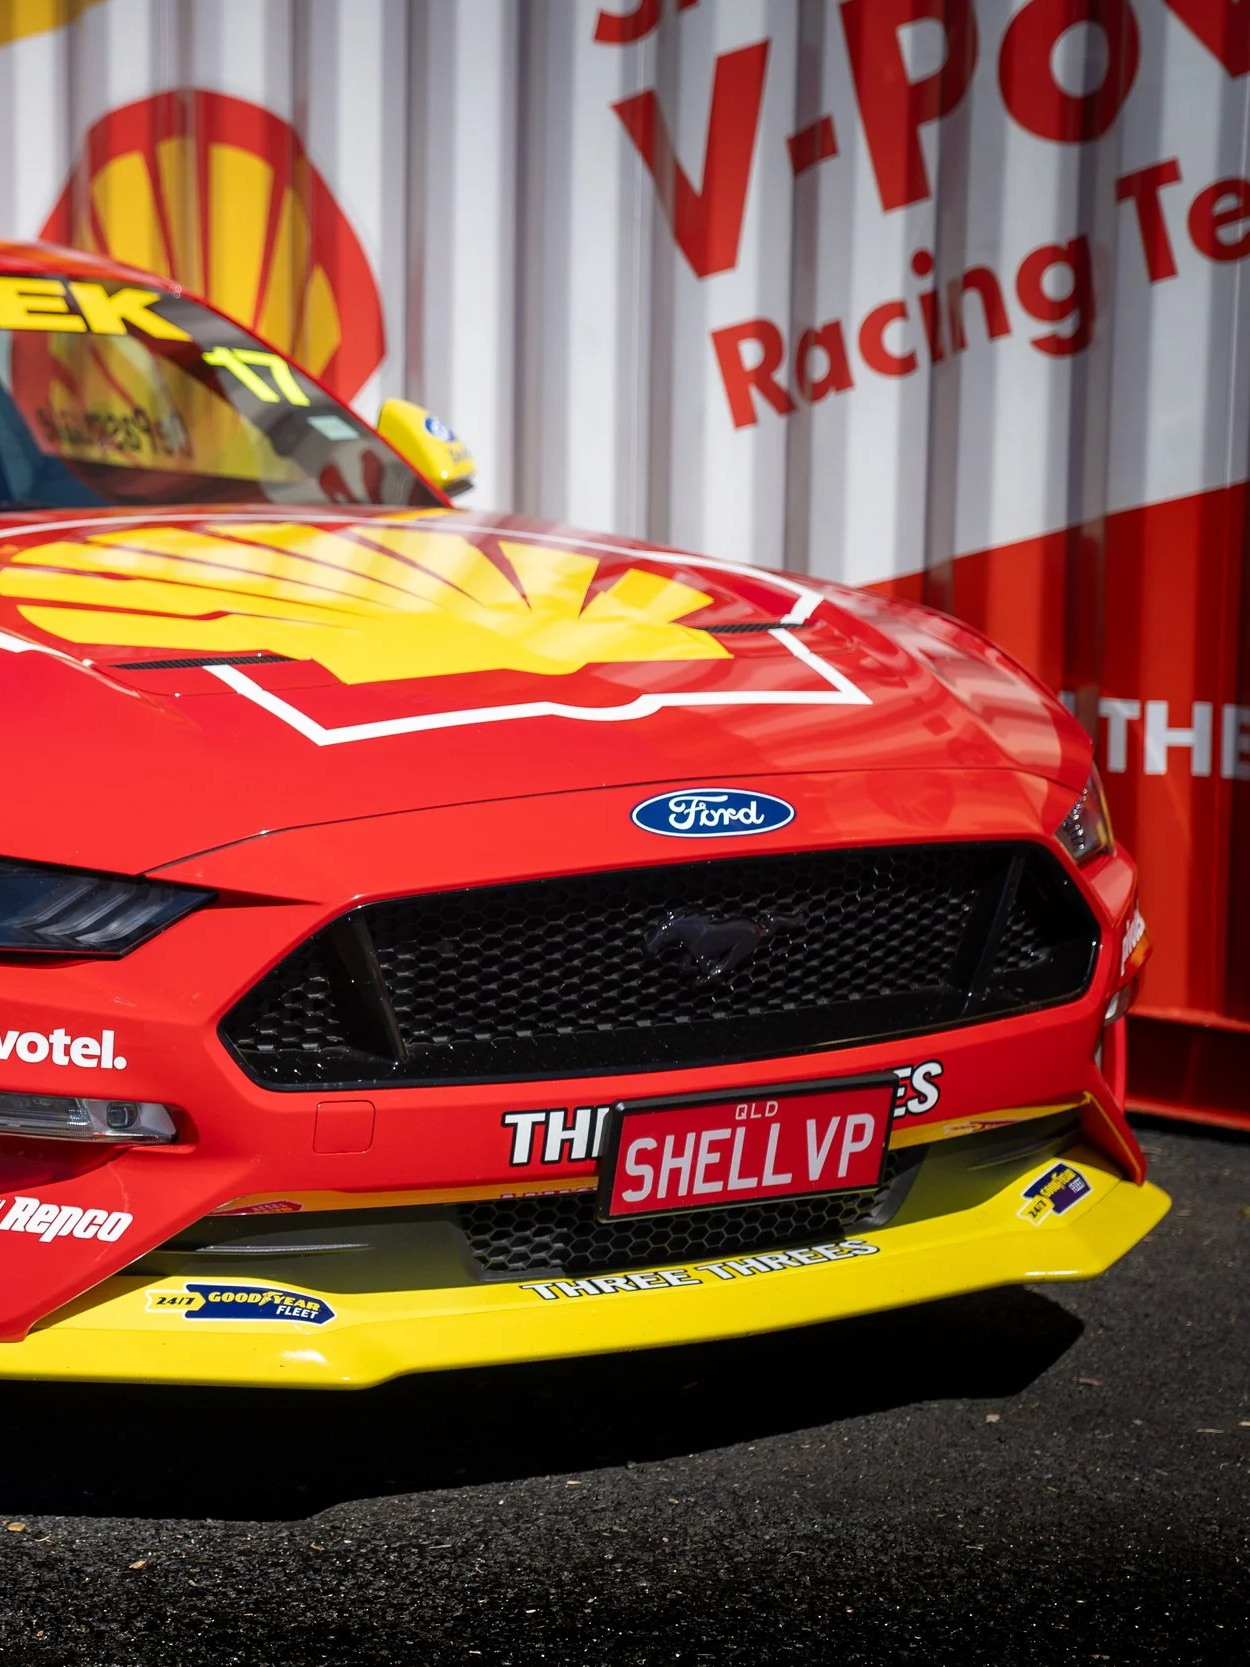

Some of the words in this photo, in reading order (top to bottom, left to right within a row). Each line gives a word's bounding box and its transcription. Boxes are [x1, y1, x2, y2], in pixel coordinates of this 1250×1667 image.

[612, 0, 1250, 282] V-Po
[710, 234, 1095, 430] Racing
[202, 346, 311, 407] 17
[668, 795, 765, 830] Ford
[735, 1100, 779, 1121] QLD
[520, 1268, 703, 1301] THREE
[697, 1239, 881, 1281] THREES
[155, 1297, 196, 1306] 24/7
[208, 1290, 322, 1312] GOODYEAR
[276, 1305, 319, 1320] FLEET
